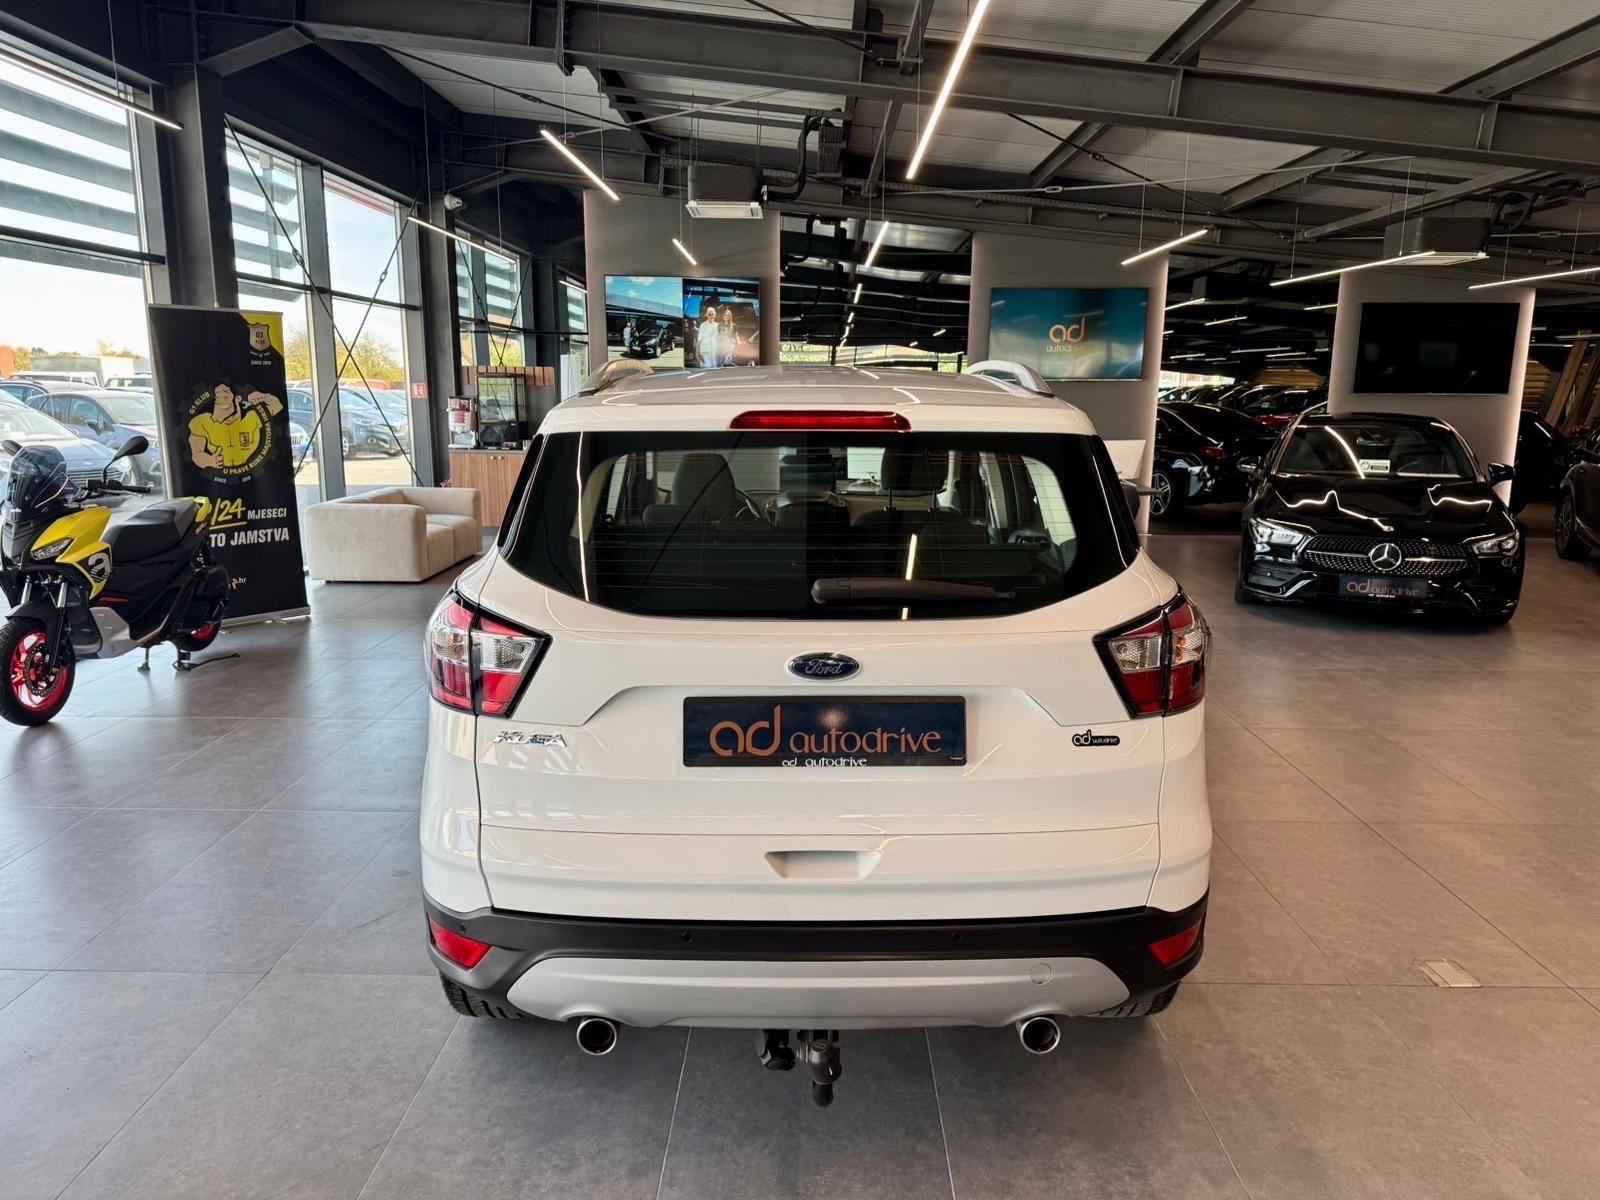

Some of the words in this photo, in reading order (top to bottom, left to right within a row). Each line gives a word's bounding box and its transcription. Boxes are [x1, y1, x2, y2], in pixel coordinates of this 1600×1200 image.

[1048, 316, 1086, 343] ad
[194, 391, 210, 407] KLUB
[229, 465, 250, 475] PRAVE
[247, 507, 288, 520] MJESECI
[230, 527, 290, 546] JAMSTVA
[1346, 579, 1370, 593] ad
[804, 658, 842, 674] Ford
[709, 704, 781, 757] ad
[789, 726, 941, 753] autodrive
[1073, 730, 1091, 745] ad
[781, 757, 797, 767] ad
[804, 757, 868, 767] autodrive
